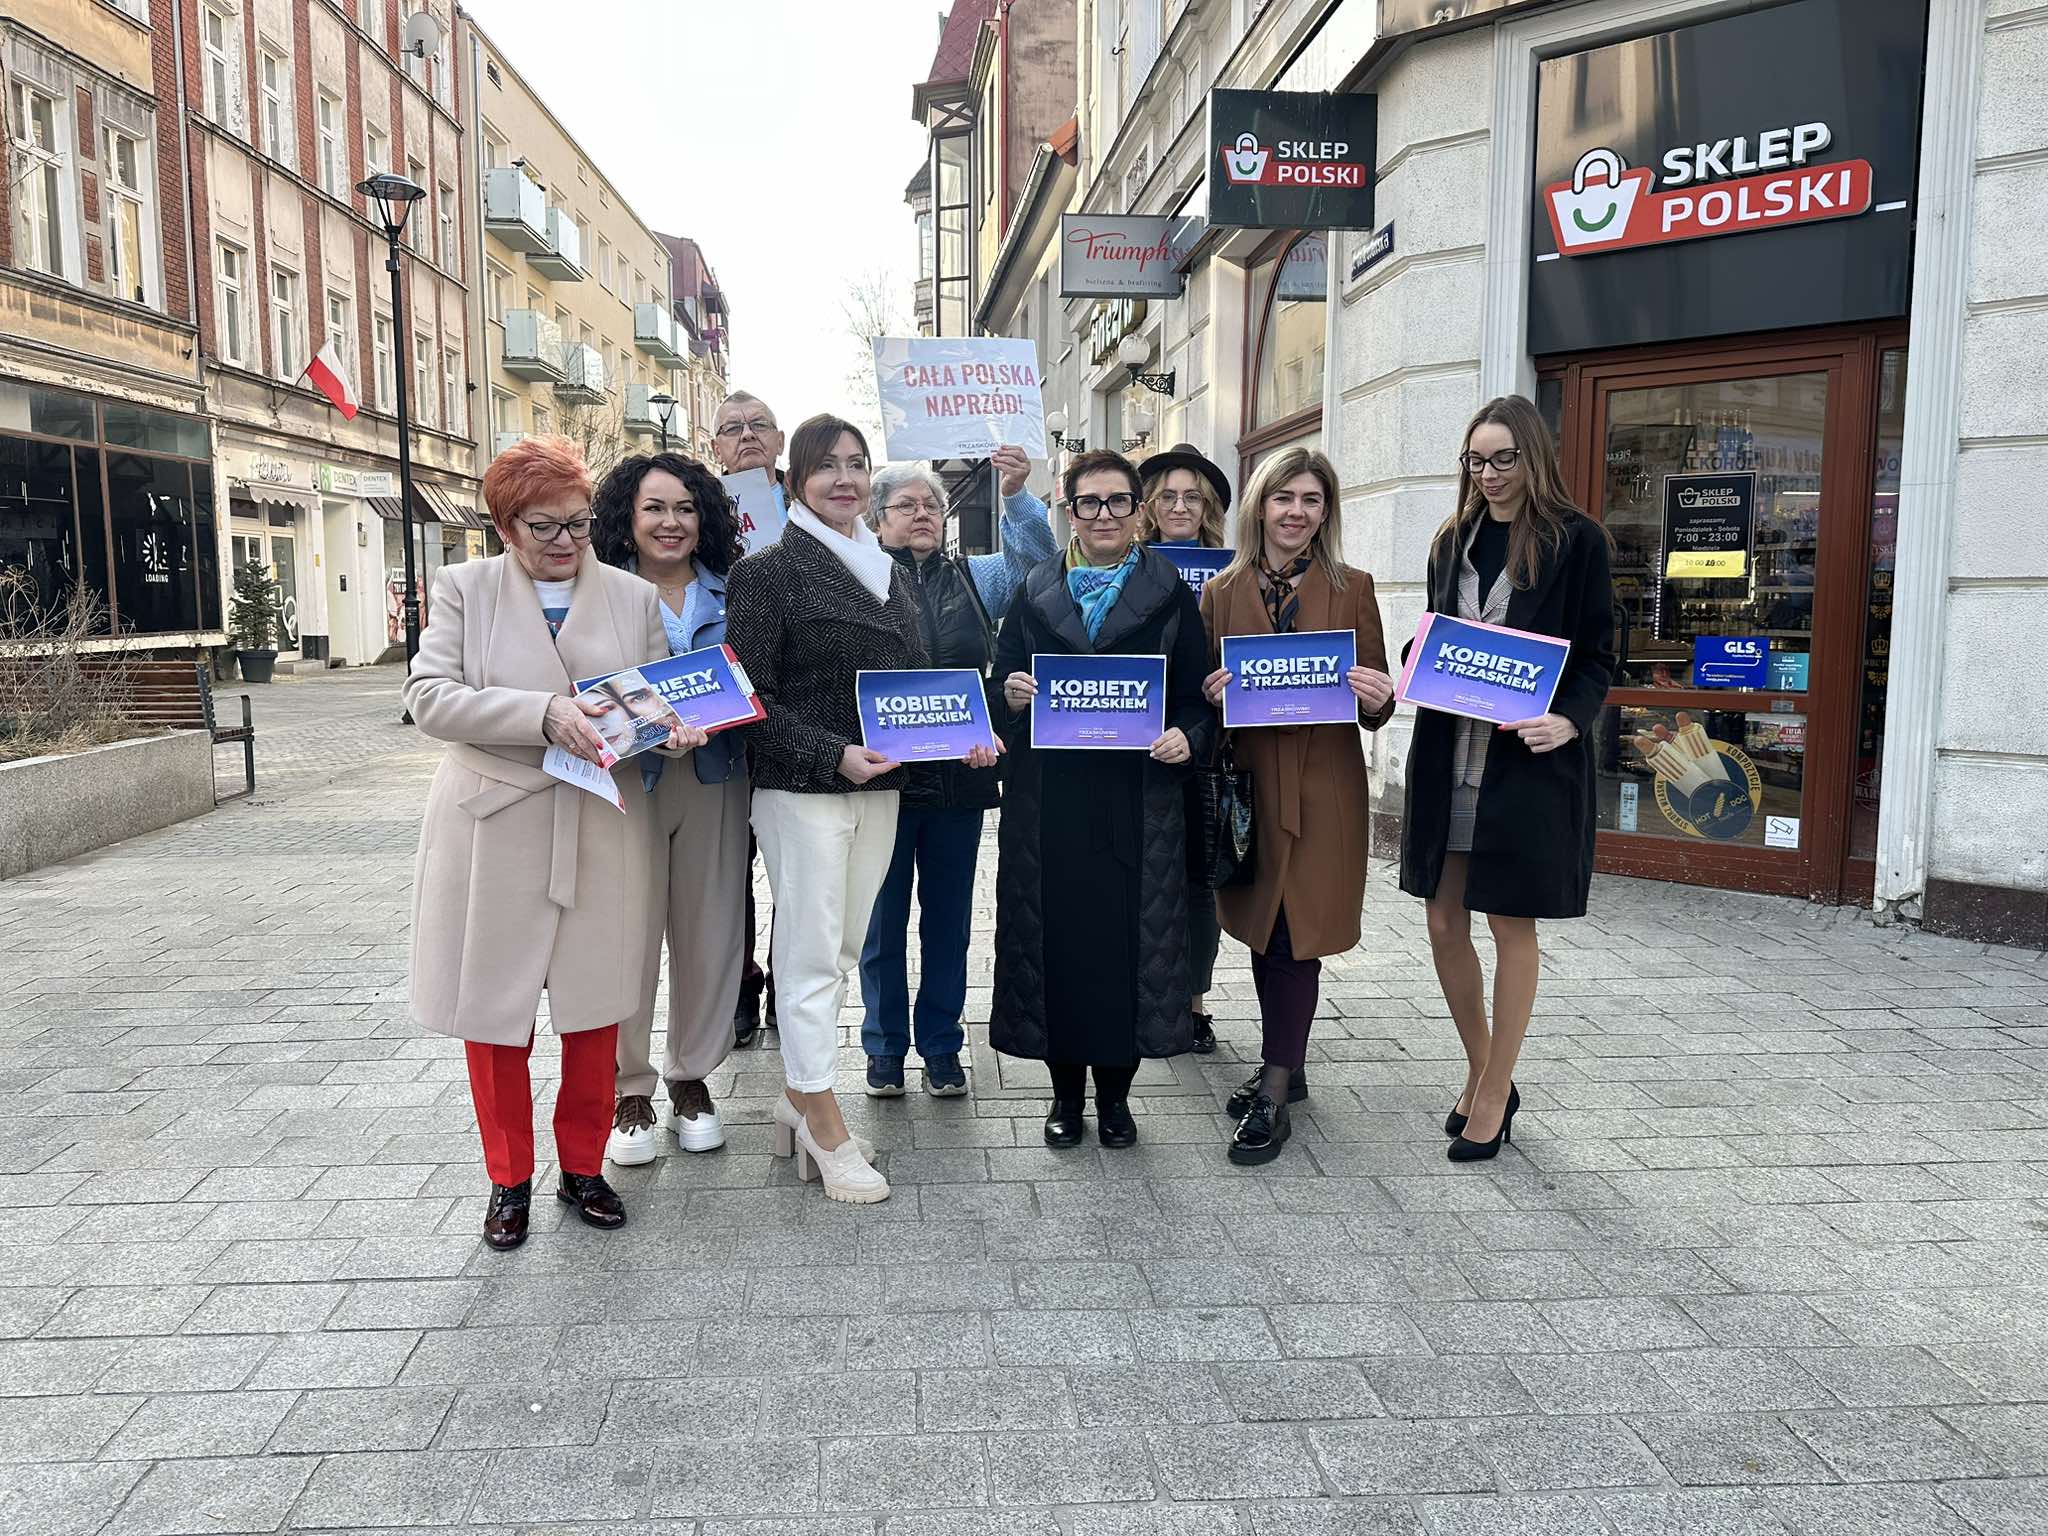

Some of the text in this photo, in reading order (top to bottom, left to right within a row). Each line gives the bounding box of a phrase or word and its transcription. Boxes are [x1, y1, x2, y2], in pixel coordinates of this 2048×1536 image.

[1278, 140, 1348, 161] SKLEP
[1662, 121, 1831, 185] SKLEP
[1277, 164, 1358, 187] POLSKI
[1661, 169, 1852, 233] POLSKI
[1067, 228, 1170, 272] Triumph
[903, 363, 1036, 387] CAŁA POLSKA
[926, 387, 1024, 417] NAPRZÓD!
[334, 471, 358, 488] DENTEX
[1702, 488, 1733, 496] SKLEP
[1702, 497, 1737, 505] POLSKI
[1676, 533, 1699, 543] 7:00
[1708, 532, 1738, 542] 23:00
[145, 573, 169, 583] LOADING
[1724, 641, 1756, 654] GLS
[1240, 655, 1338, 675] KOBIETY
[1438, 642, 1544, 680] KOBIETY
[651, 668, 713, 695] BIETY
[1241, 672, 1338, 688] z TRZASKIEM
[1434, 660, 1537, 692] z TRZASKIEM
[1050, 679, 1149, 696] KOBIETY
[874, 693, 968, 713] KOBIETY
[1050, 697, 1147, 709] z TRZASKIEM
[877, 710, 972, 726] z TRZASKIEM
[1729, 794, 1748, 807] DOG
[1694, 812, 1711, 825] HOT
